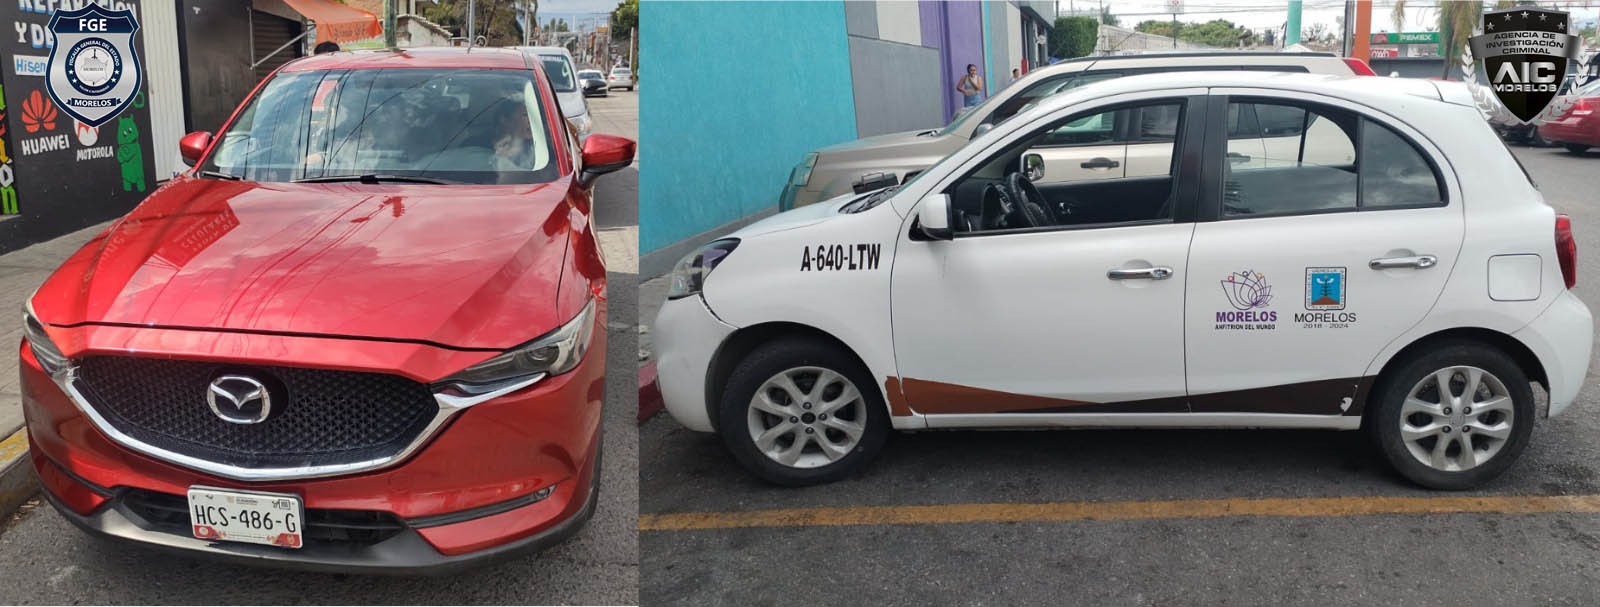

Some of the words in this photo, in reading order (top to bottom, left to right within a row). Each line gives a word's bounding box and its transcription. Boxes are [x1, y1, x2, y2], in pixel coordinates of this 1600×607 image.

[14, 21, 27, 43] Y
[21, 134, 70, 155] HUAWEI
[76, 145, 114, 162] MOTOROLA
[800, 243, 881, 271] A-640-LTW
[1216, 311, 1277, 322] MORELOS
[1294, 312, 1357, 323] MORELOS
[195, 505, 296, 533] HCS-486-G
